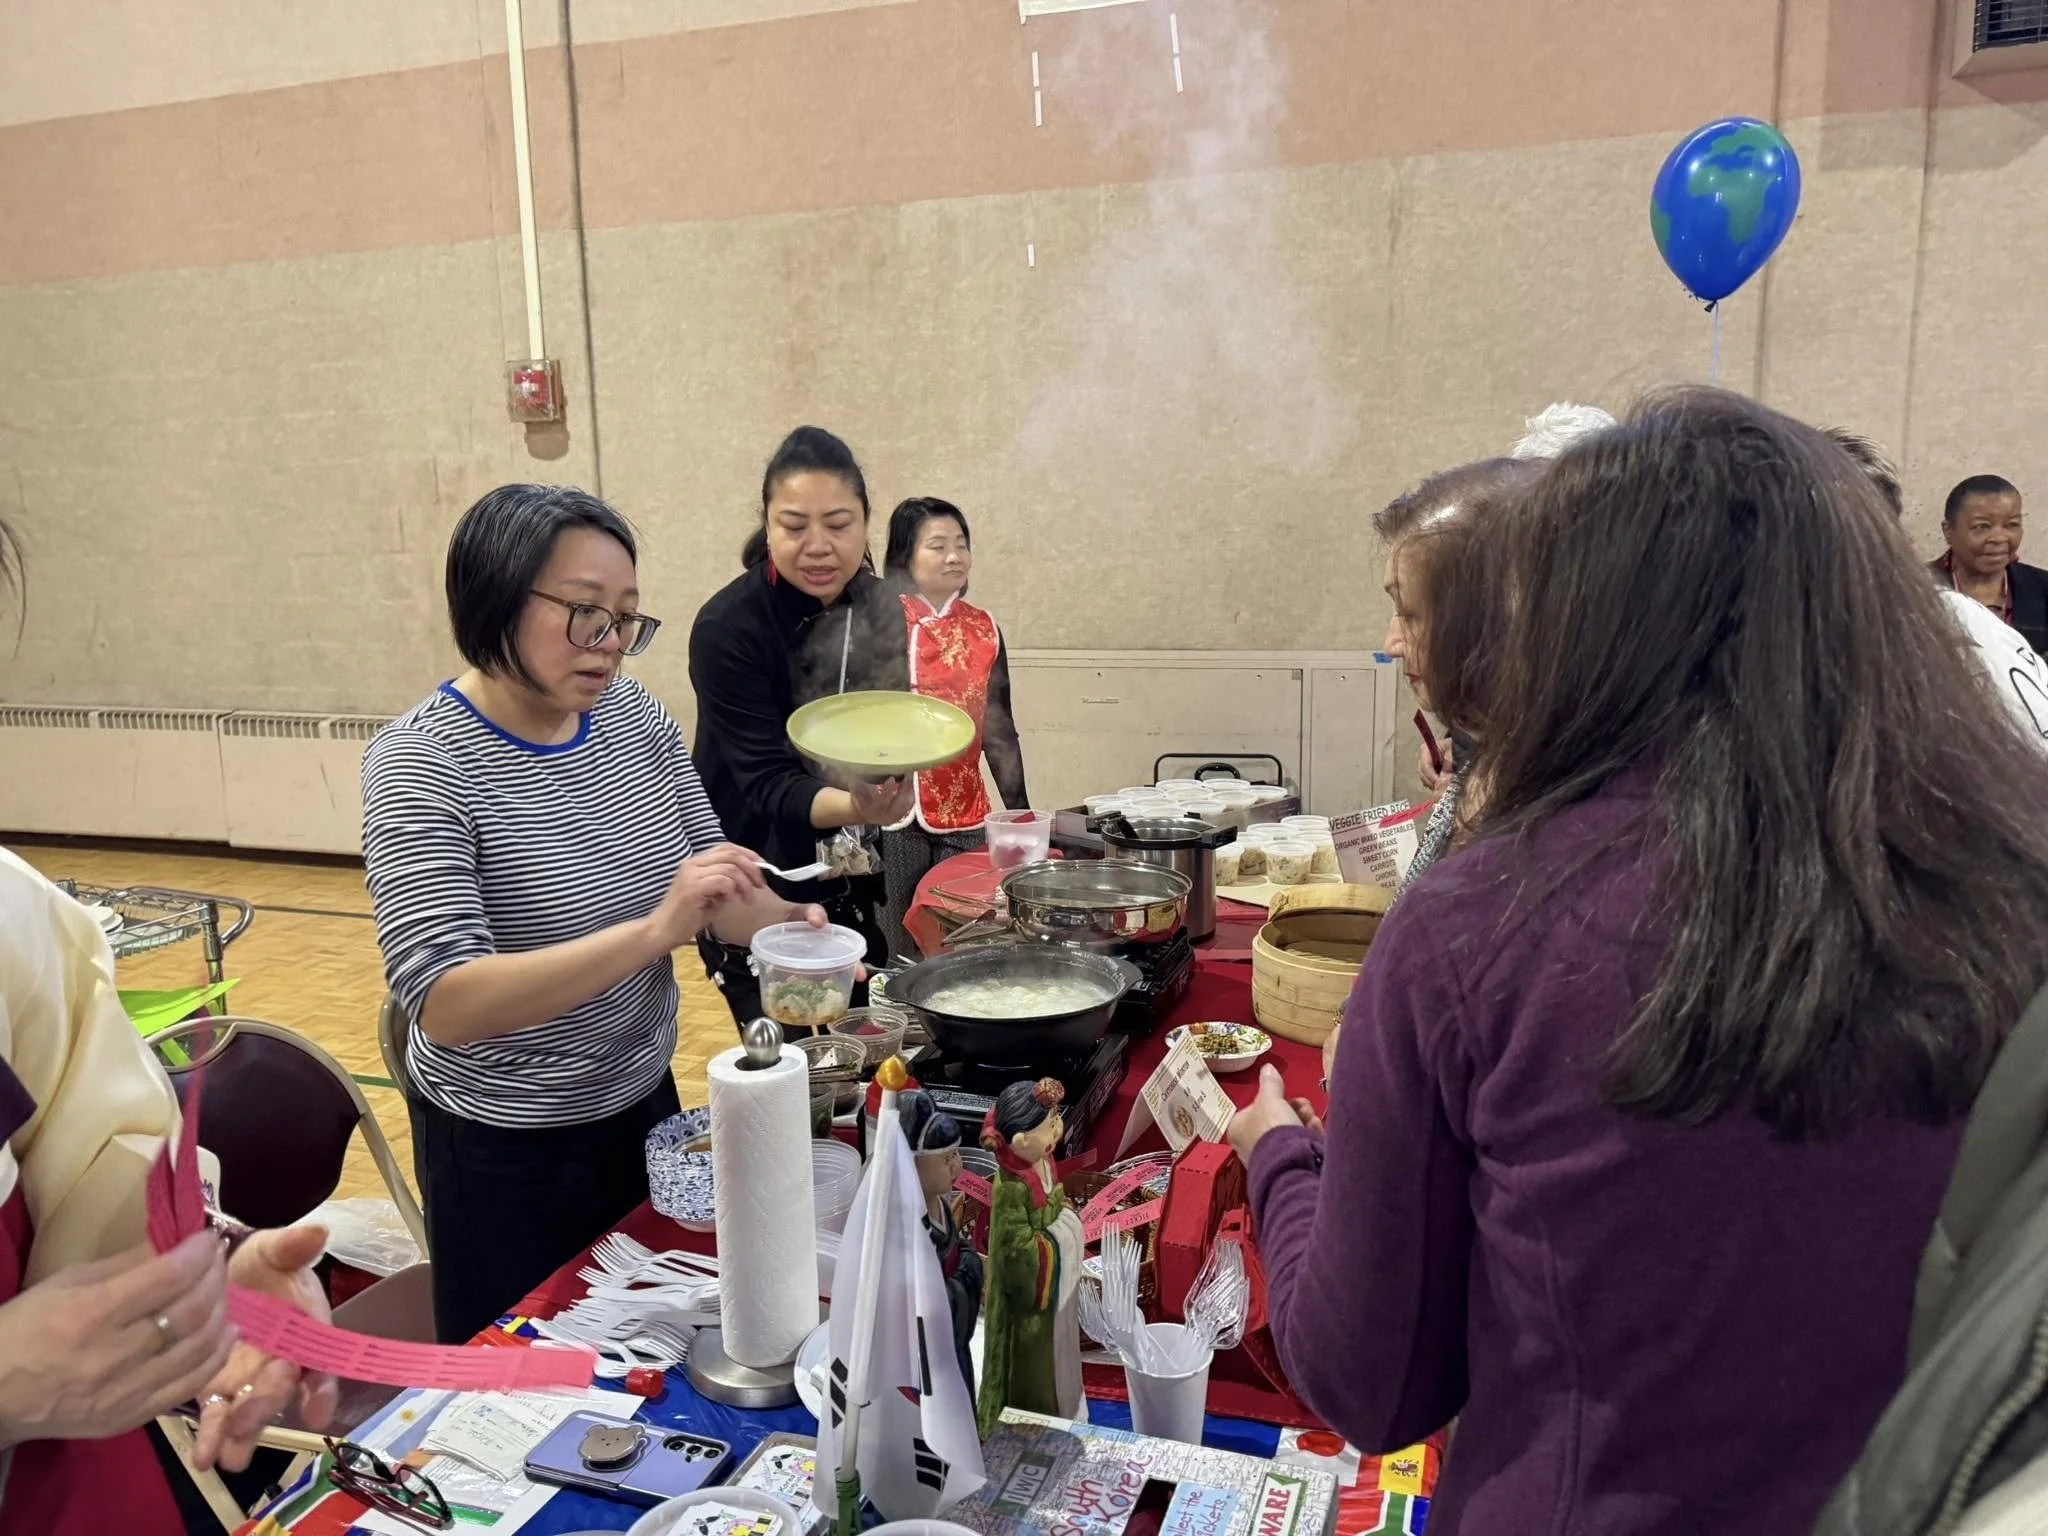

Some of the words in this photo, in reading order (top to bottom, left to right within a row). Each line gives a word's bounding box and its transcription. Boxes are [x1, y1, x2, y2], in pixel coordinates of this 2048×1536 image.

[1329, 813, 1361, 831] VEGGIE
[1363, 807, 1388, 820] FRIED
[1390, 801, 1410, 813] RICE
[1335, 838, 1360, 850] ORGANIC
[1361, 833, 1378, 843] MIXED
[1379, 824, 1414, 838] VEGETABLES
[1359, 844, 1378, 855] GREEN
[1379, 838, 1398, 850] BEANS
[1363, 853, 1381, 864] SWEET
[1382, 848, 1399, 858] CORN
[1370, 859, 1397, 873] CARROTS
[1126, 1212, 1148, 1225] TICKET
[1095, 1455, 1153, 1522] Korea
[1050, 1479, 1104, 1536] South
[1180, 1491, 1202, 1507] the
